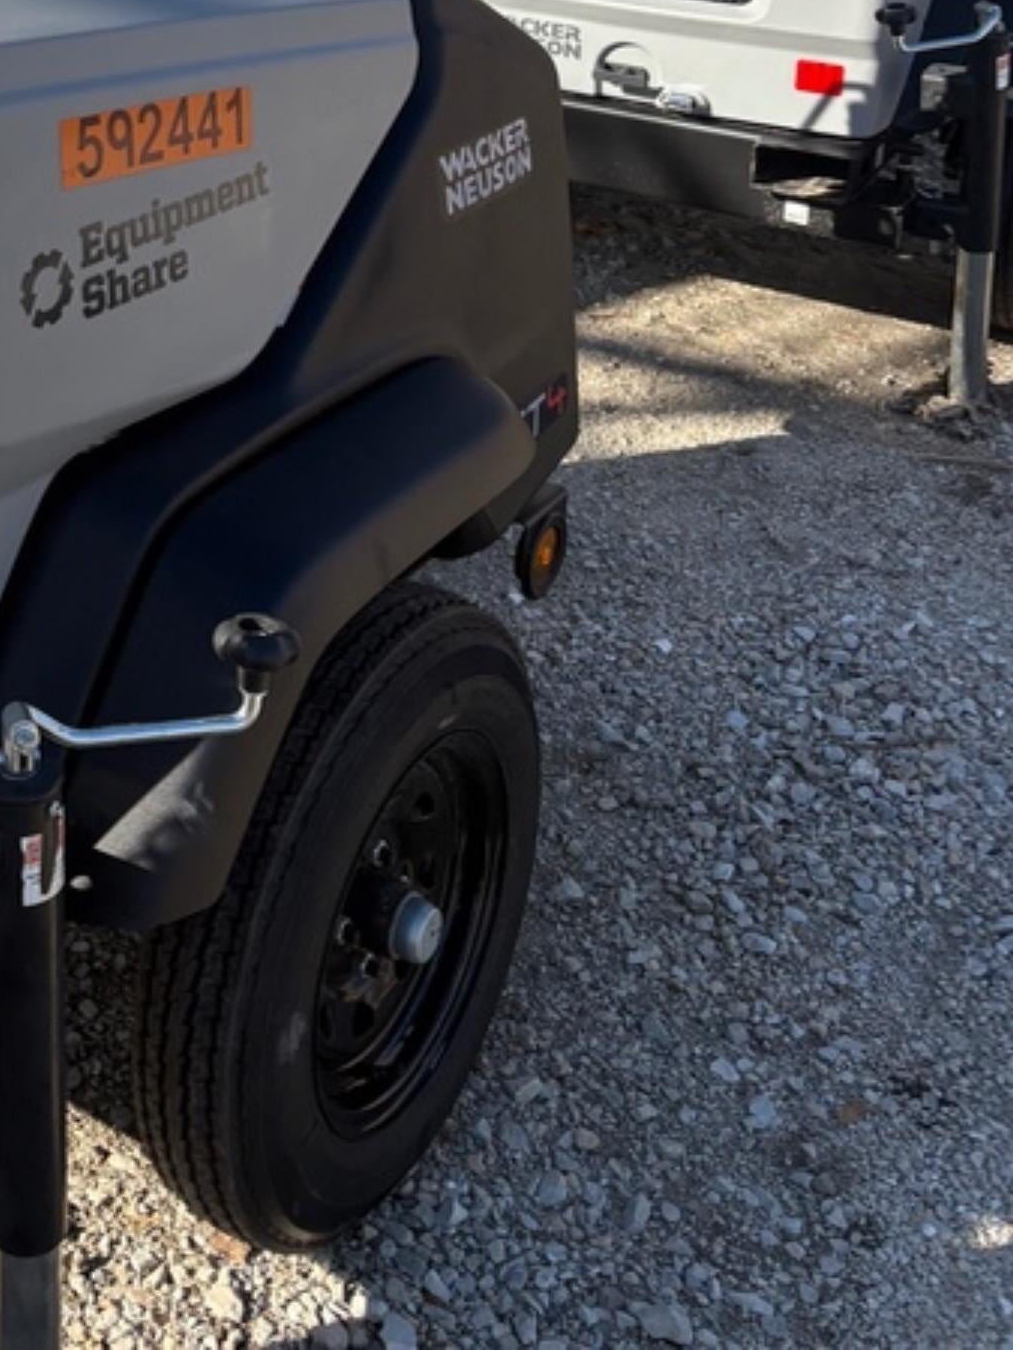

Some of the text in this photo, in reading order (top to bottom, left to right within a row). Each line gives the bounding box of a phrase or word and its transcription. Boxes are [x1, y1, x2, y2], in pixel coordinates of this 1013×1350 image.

[510, 17, 582, 43] CKER
[76, 87, 245, 179] 592441
[439, 117, 529, 182] WACKER
[79, 160, 270, 268] Equipment
[446, 146, 531, 215] NEUSON
[81, 250, 189, 320] Share
